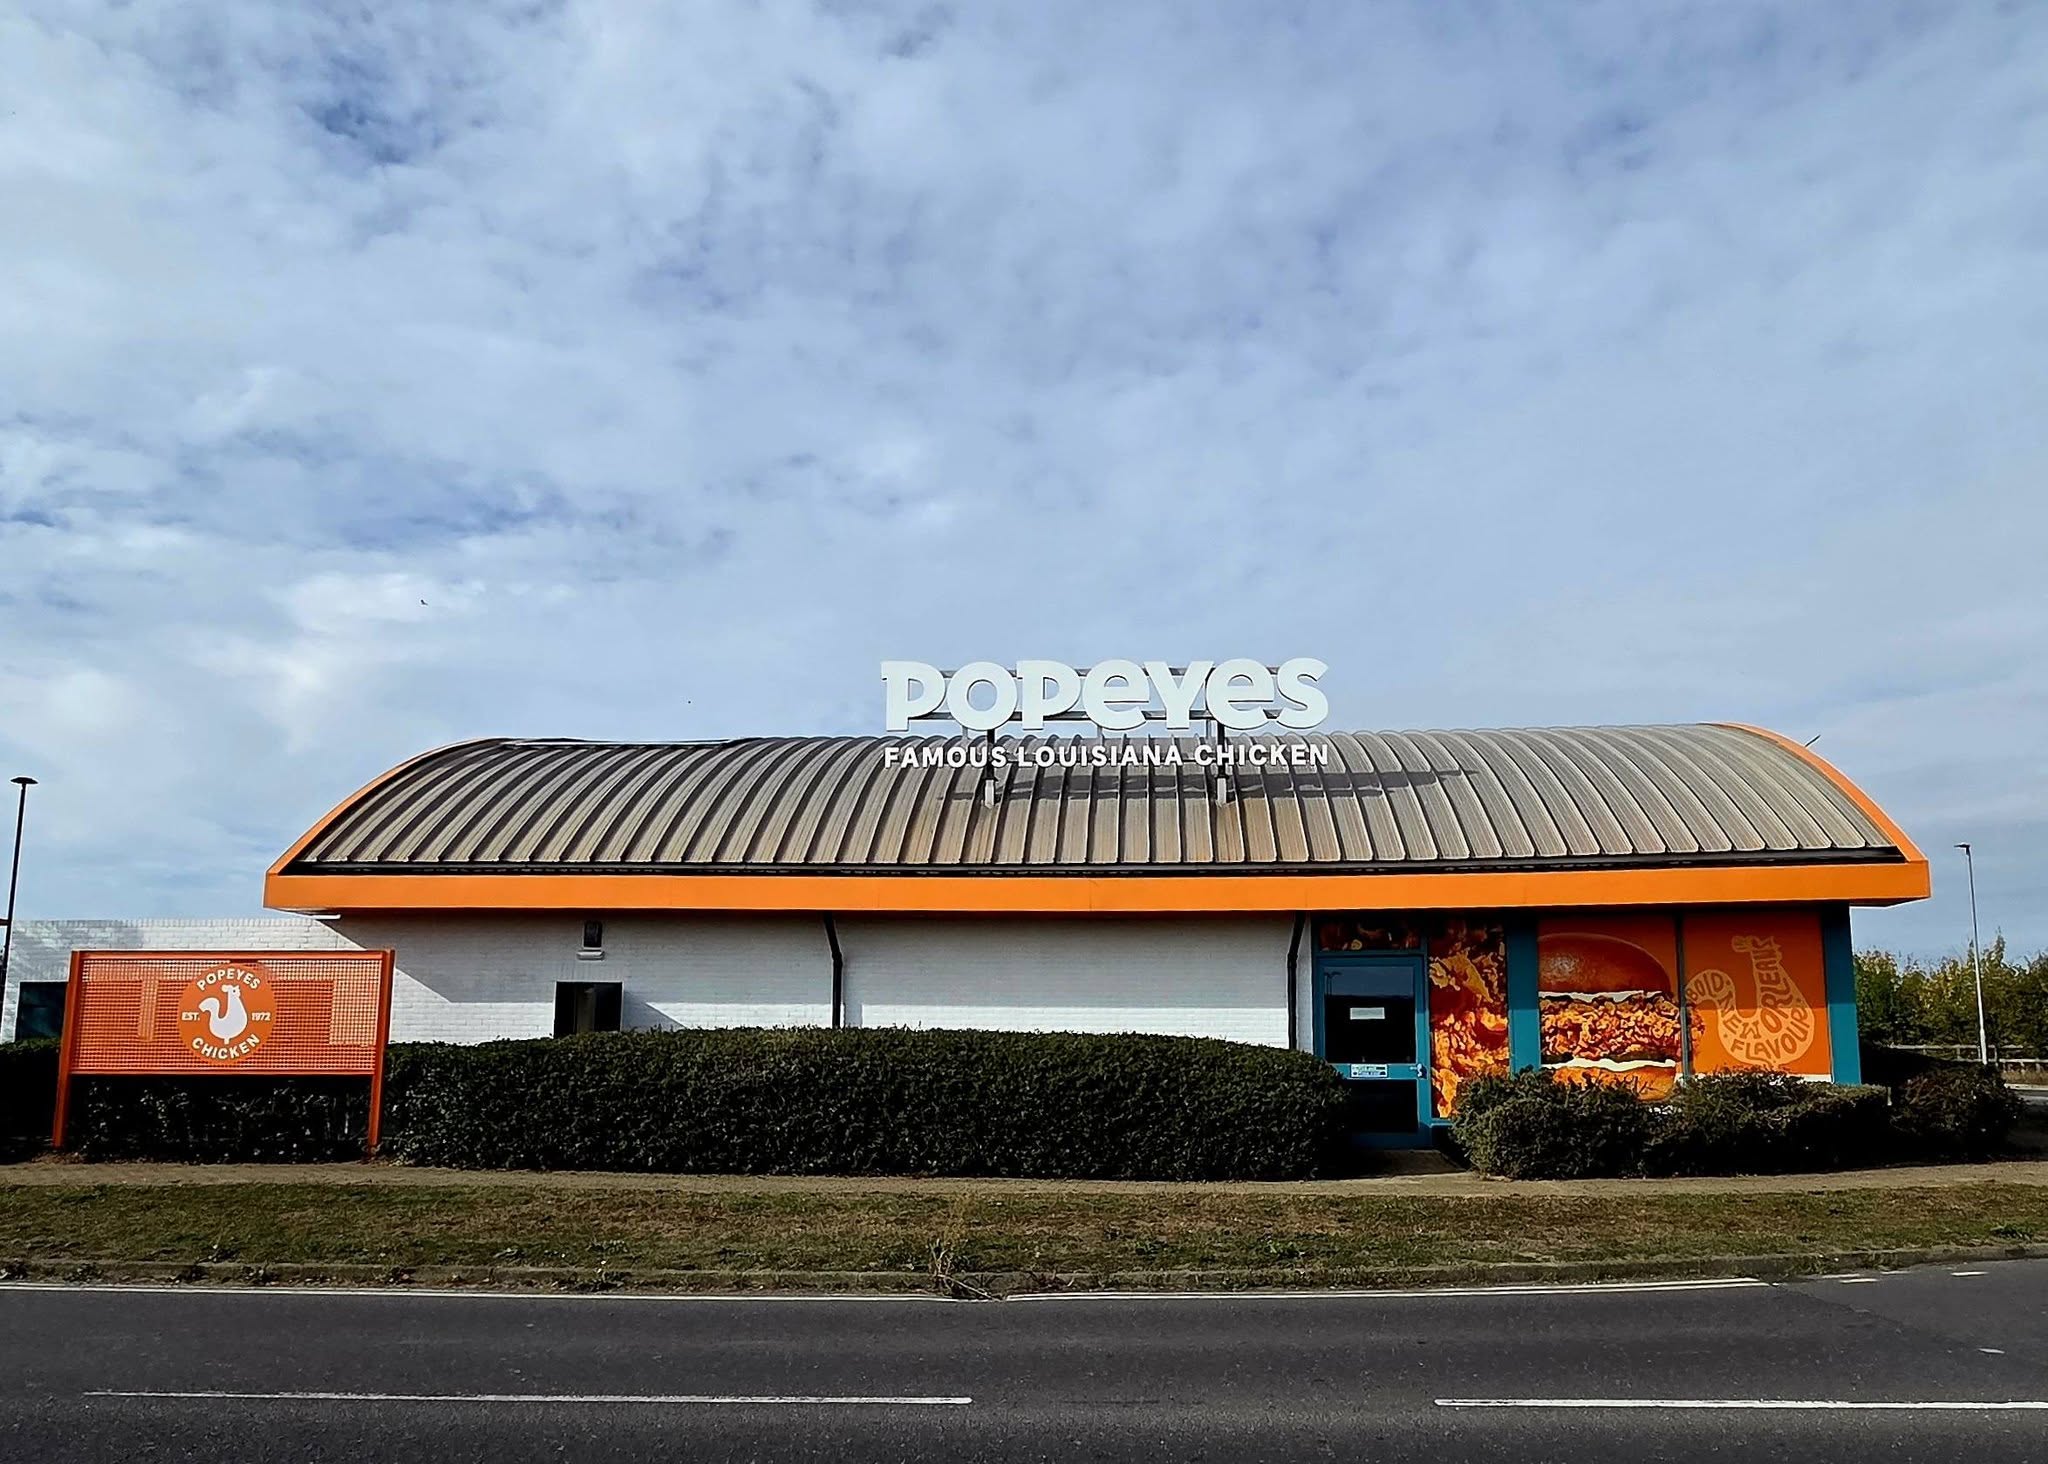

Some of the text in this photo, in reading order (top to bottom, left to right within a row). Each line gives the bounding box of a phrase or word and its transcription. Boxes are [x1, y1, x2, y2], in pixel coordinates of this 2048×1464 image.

[884, 743, 1328, 769] FAMOUS LOUISIANA CHICKEN
[196, 968, 261, 991] POPEYES
[1685, 972, 1724, 1002] BOLD
[251, 1012, 271, 1021] 1972
[1717, 991, 1761, 1039] NEW
[192, 1033, 260, 1059] CHICKEN
[1730, 1001, 1810, 1069] FLAVOUR
